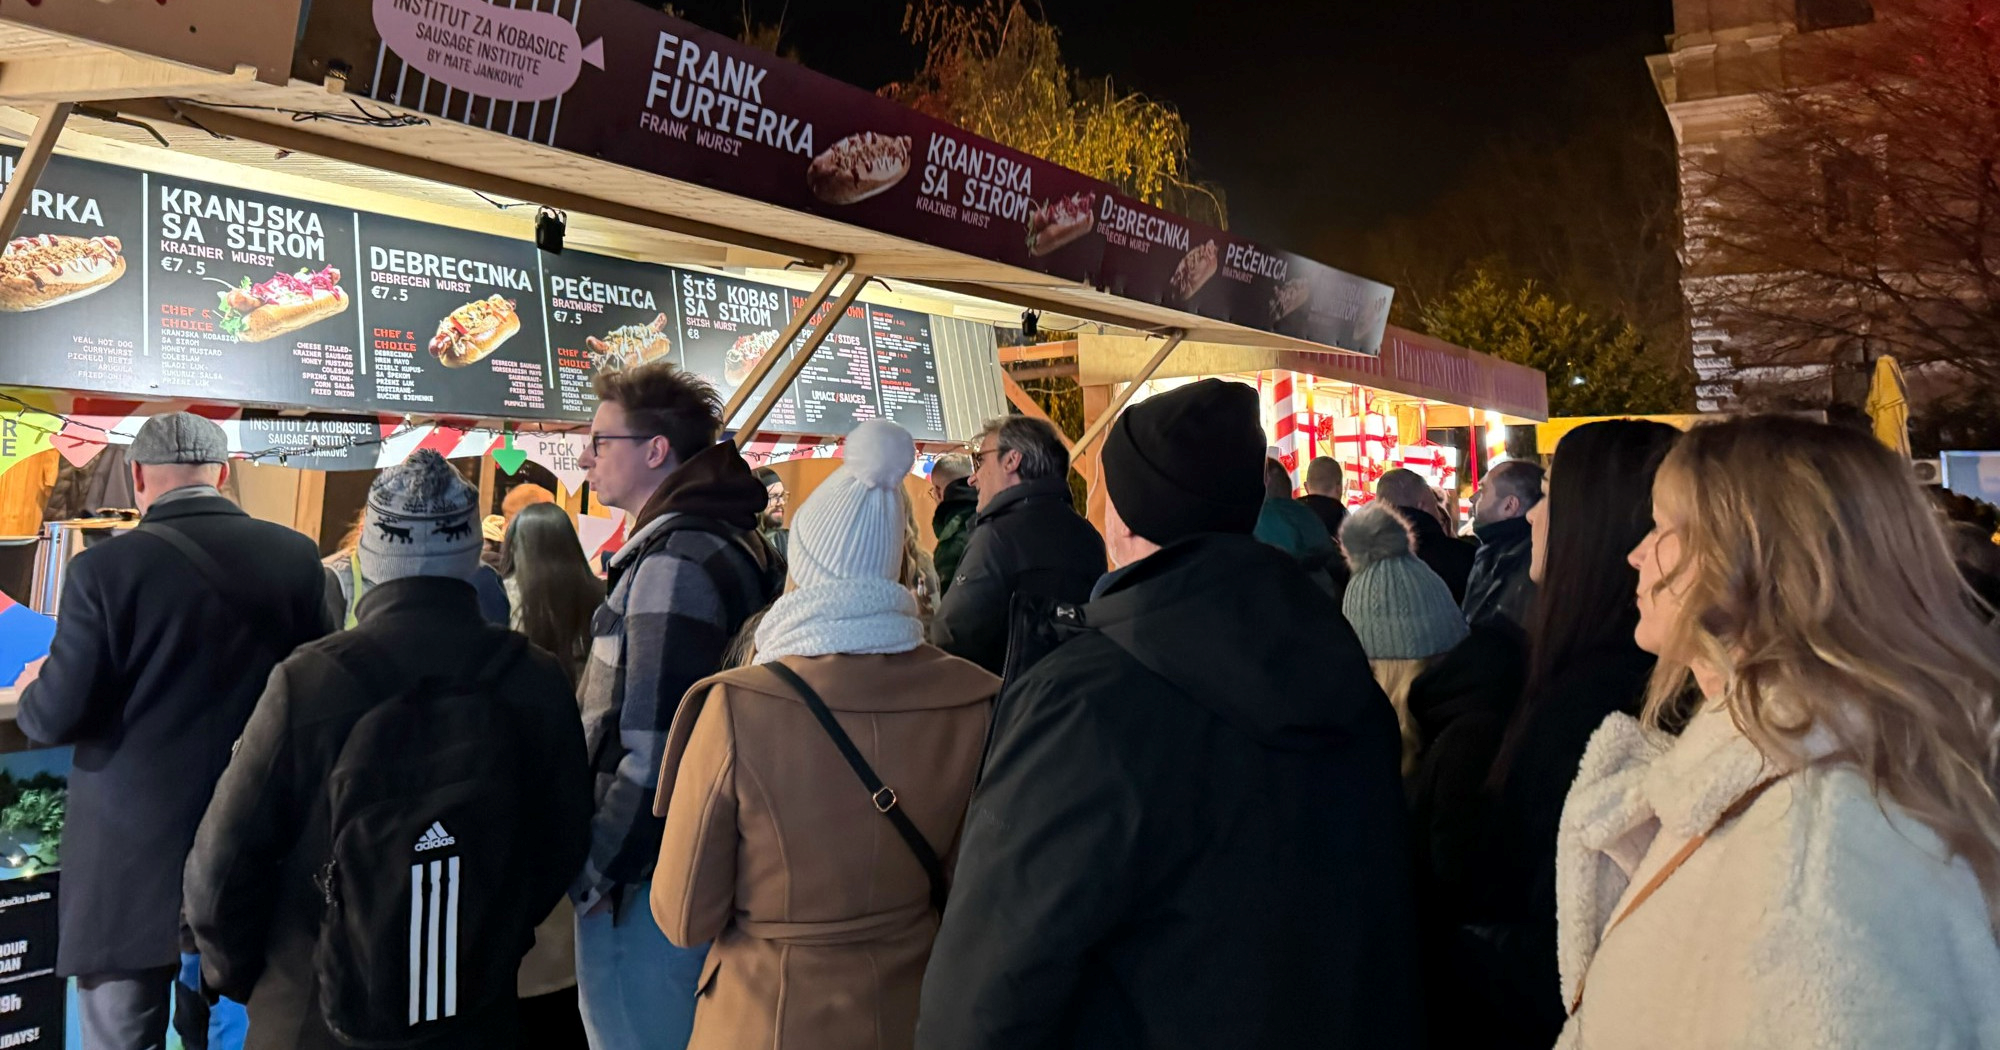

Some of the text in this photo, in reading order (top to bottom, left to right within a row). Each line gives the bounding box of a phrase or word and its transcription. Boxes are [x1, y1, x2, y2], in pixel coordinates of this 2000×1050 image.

[472, 15, 492, 39] ZA
[496, 22, 569, 64] KOBASICE
[415, 22, 541, 75] SAUSAGE INSTITUTE
[427, 48, 524, 88] BY MATE JANKOVIĆ
[654, 30, 767, 104] FRANK
[646, 70, 813, 158] FURTERKA
[640, 111, 742, 157] FRANK WURST
[927, 132, 1031, 195] KRANJSKA
[921, 164, 1029, 223] SA SIROM
[22, 189, 104, 227] RKA
[161, 185, 325, 238] KRANJSKA
[916, 195, 990, 229] KRAINER WURST
[162, 213, 325, 262] SA SIROM
[1130, 236, 1150, 253] WURST
[161, 240, 275, 267] KRAINER WURST
[161, 256, 206, 275] €7.5
[370, 245, 534, 293] DEBRECINKA
[1225, 243, 1288, 281] PEČENICA
[371, 271, 471, 294] DEBRECEN WURST
[371, 285, 408, 302] €7.5
[551, 275, 657, 311] PEČENICA
[683, 274, 779, 310] ŠIŠ KOBAS
[161, 304, 196, 316] CHEF
[552, 297, 604, 314] BRATWURST
[685, 298, 772, 327] SA SIROM
[847, 306, 865, 319] OWN
[161, 318, 214, 332] CHOICE
[554, 310, 583, 325] €7.5
[686, 317, 737, 332] SHISH WURST
[161, 329, 199, 339] KRANJSKA
[374, 328, 401, 339] CHEF
[687, 328, 700, 340] €8
[73, 336, 133, 348] VEAL HOT DOG
[161, 336, 200, 347] SA SIROM
[296, 342, 321, 351] CHEESE
[374, 340, 417, 352] CHOICE
[161, 345, 222, 357] HONEY MUSTARD
[162, 353, 200, 362] COLESLAW
[293, 349, 353, 361] KRAINER SAUSAGE
[558, 348, 579, 357] CHEF
[301, 357, 353, 368] HONEY MUSTARD
[559, 358, 591, 369] CHOICE
[302, 372, 327, 380] SPRING
[322, 366, 354, 375] COLESLAW
[311, 388, 355, 398] FRIED ONION
[334, 382, 354, 390] SALSA
[250, 418, 373, 435] INSTITUT ZA KOBASICE
[268, 433, 309, 445] SAUSAGE
[539, 442, 574, 456] PICK
[553, 457, 580, 471] HER
[415, 836, 455, 851] adidas
